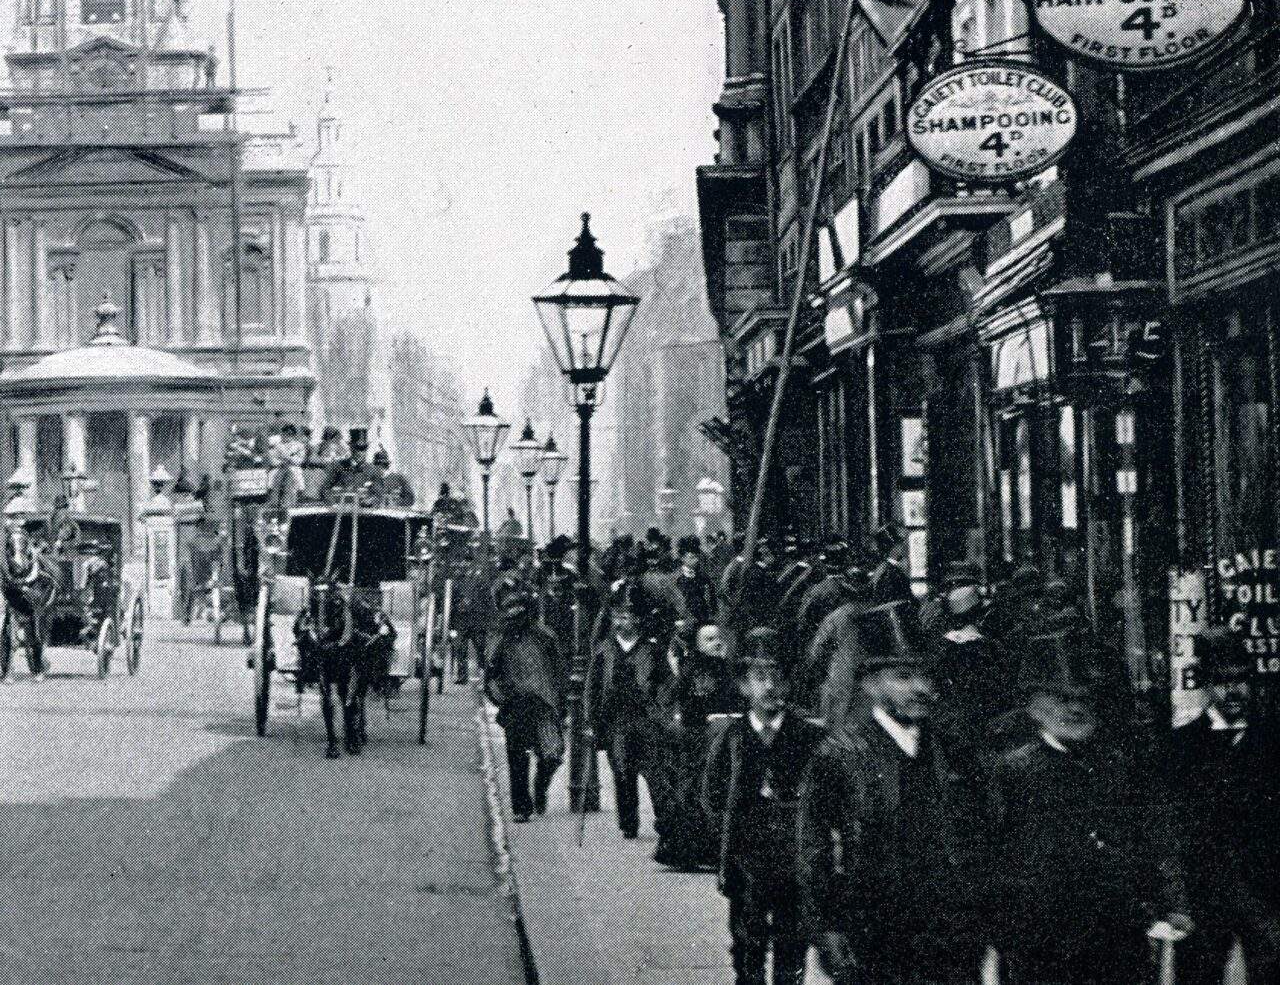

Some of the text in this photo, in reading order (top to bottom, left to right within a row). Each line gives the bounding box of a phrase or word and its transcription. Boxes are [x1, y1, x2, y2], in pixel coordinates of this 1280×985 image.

[1071, 27, 1210, 59] FIRST FLOOR
[914, 70, 1068, 115] GAIETY TOILET CLUB
[913, 109, 1071, 134] SHAMPOOING
[1221, 583, 1278, 604] TOIL
